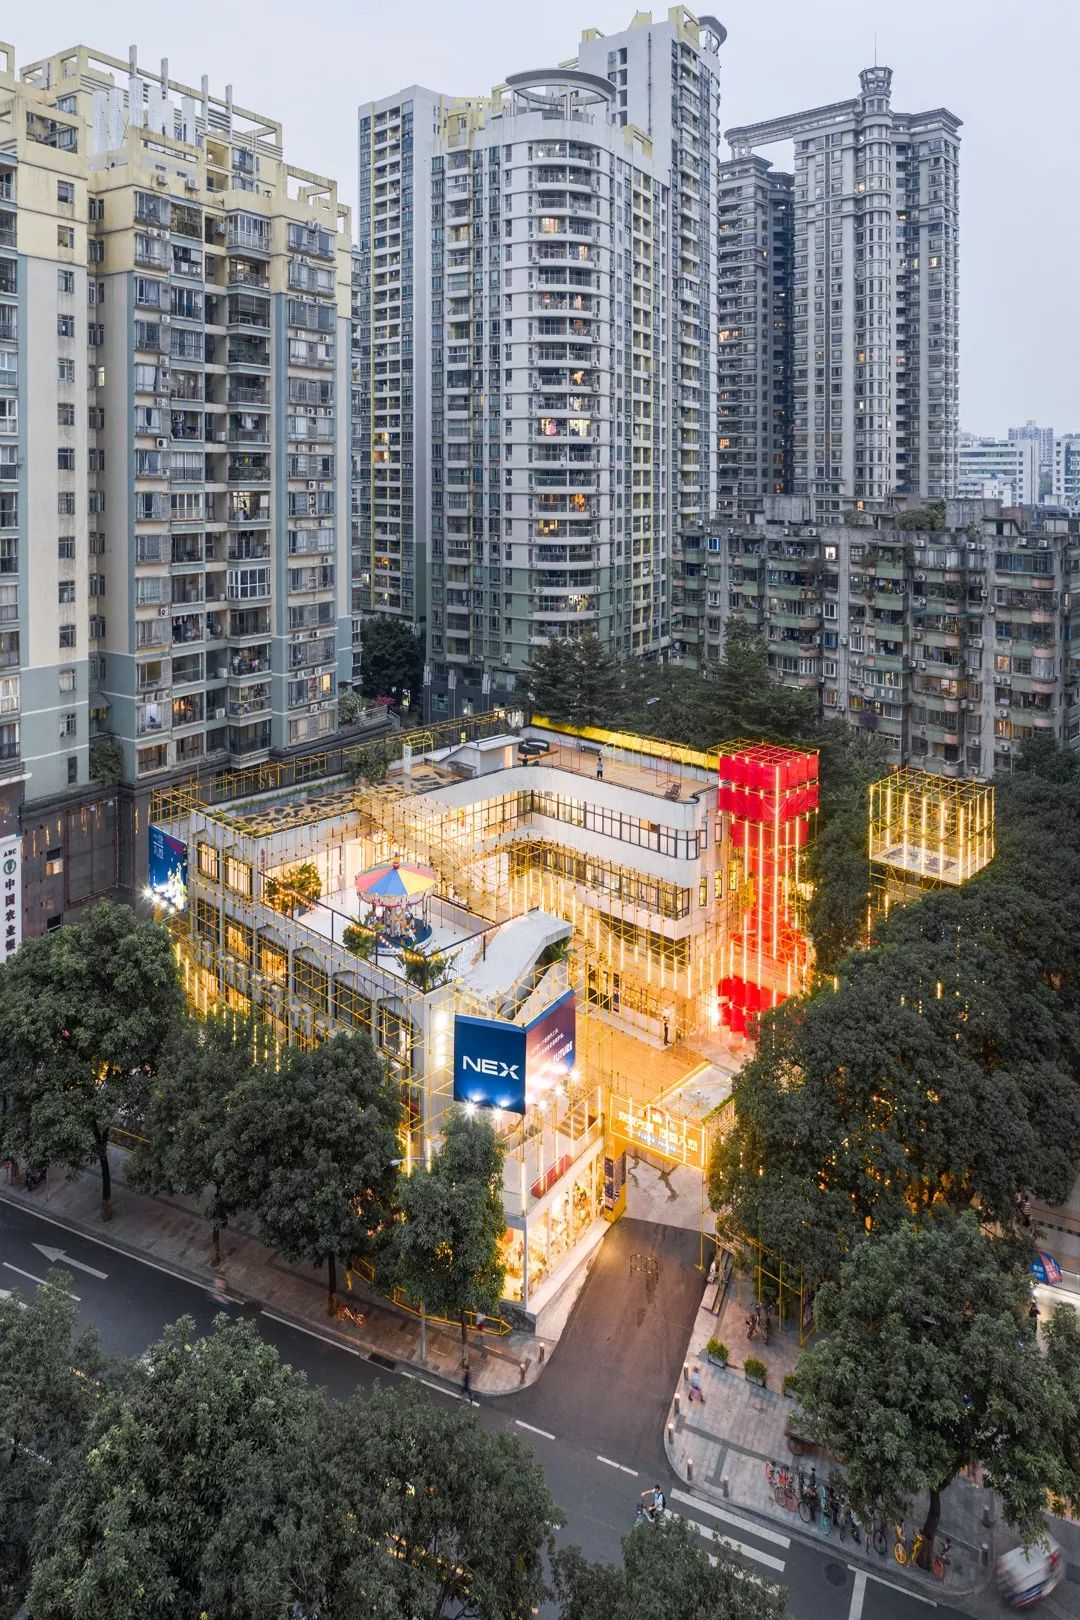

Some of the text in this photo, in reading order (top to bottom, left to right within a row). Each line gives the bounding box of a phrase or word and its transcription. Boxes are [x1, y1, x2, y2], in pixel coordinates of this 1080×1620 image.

[3, 848, 17, 858] ABC
[552, 1041, 573, 1064] FUTURE
[462, 1055, 520, 1080] NEX
